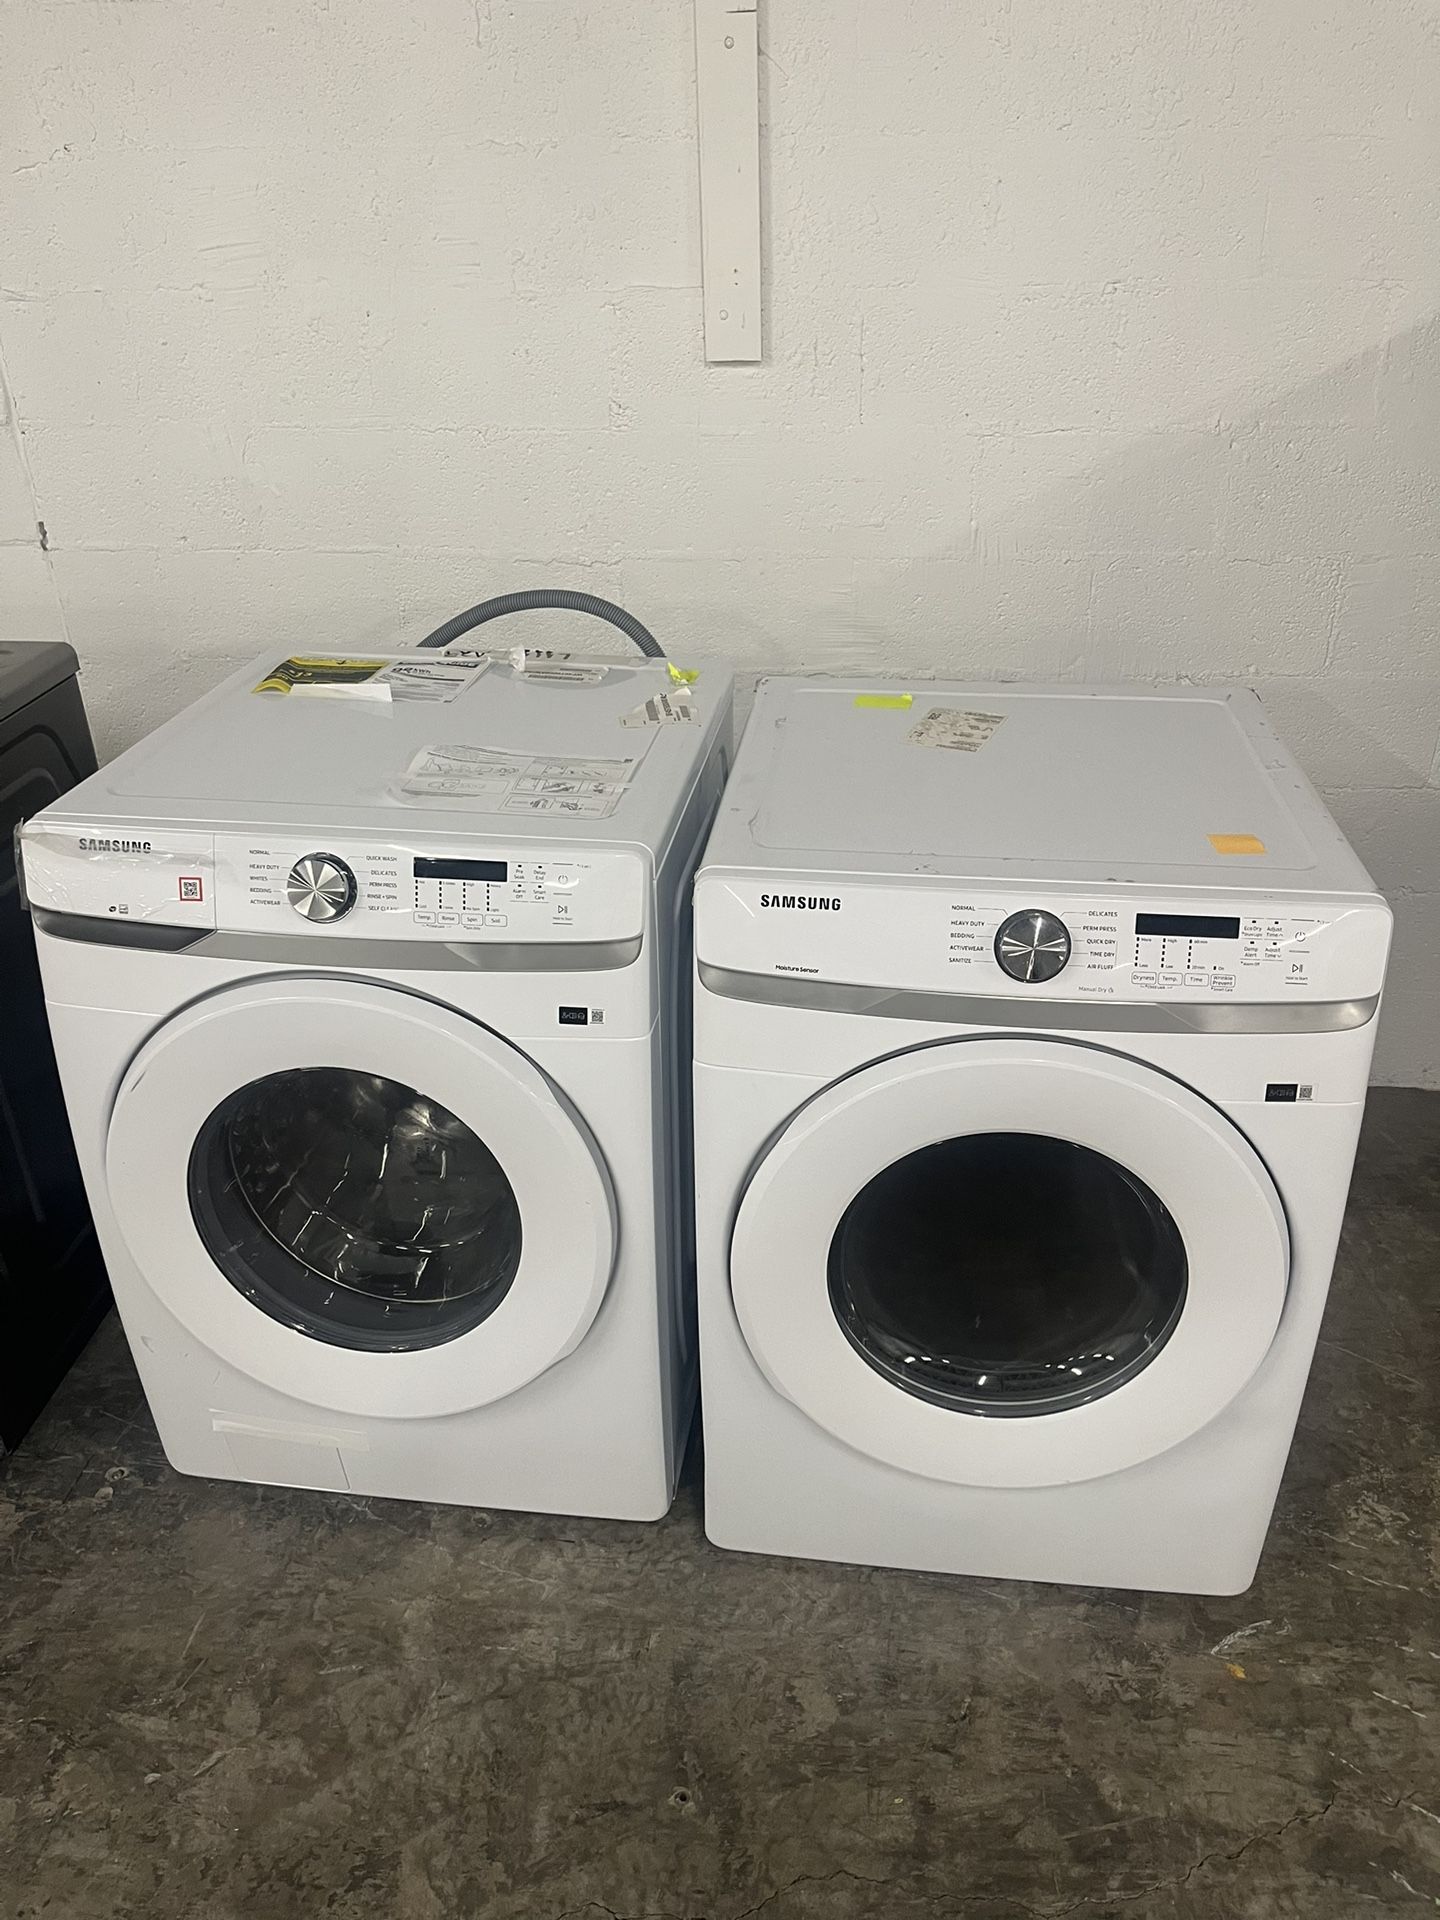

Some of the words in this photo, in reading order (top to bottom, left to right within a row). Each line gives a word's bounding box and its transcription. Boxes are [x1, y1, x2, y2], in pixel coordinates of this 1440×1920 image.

[79, 838, 152, 854] SAMSUNG
[760, 894, 842, 911] SAMSUNG
[1133, 974, 1155, 982] Dryness
